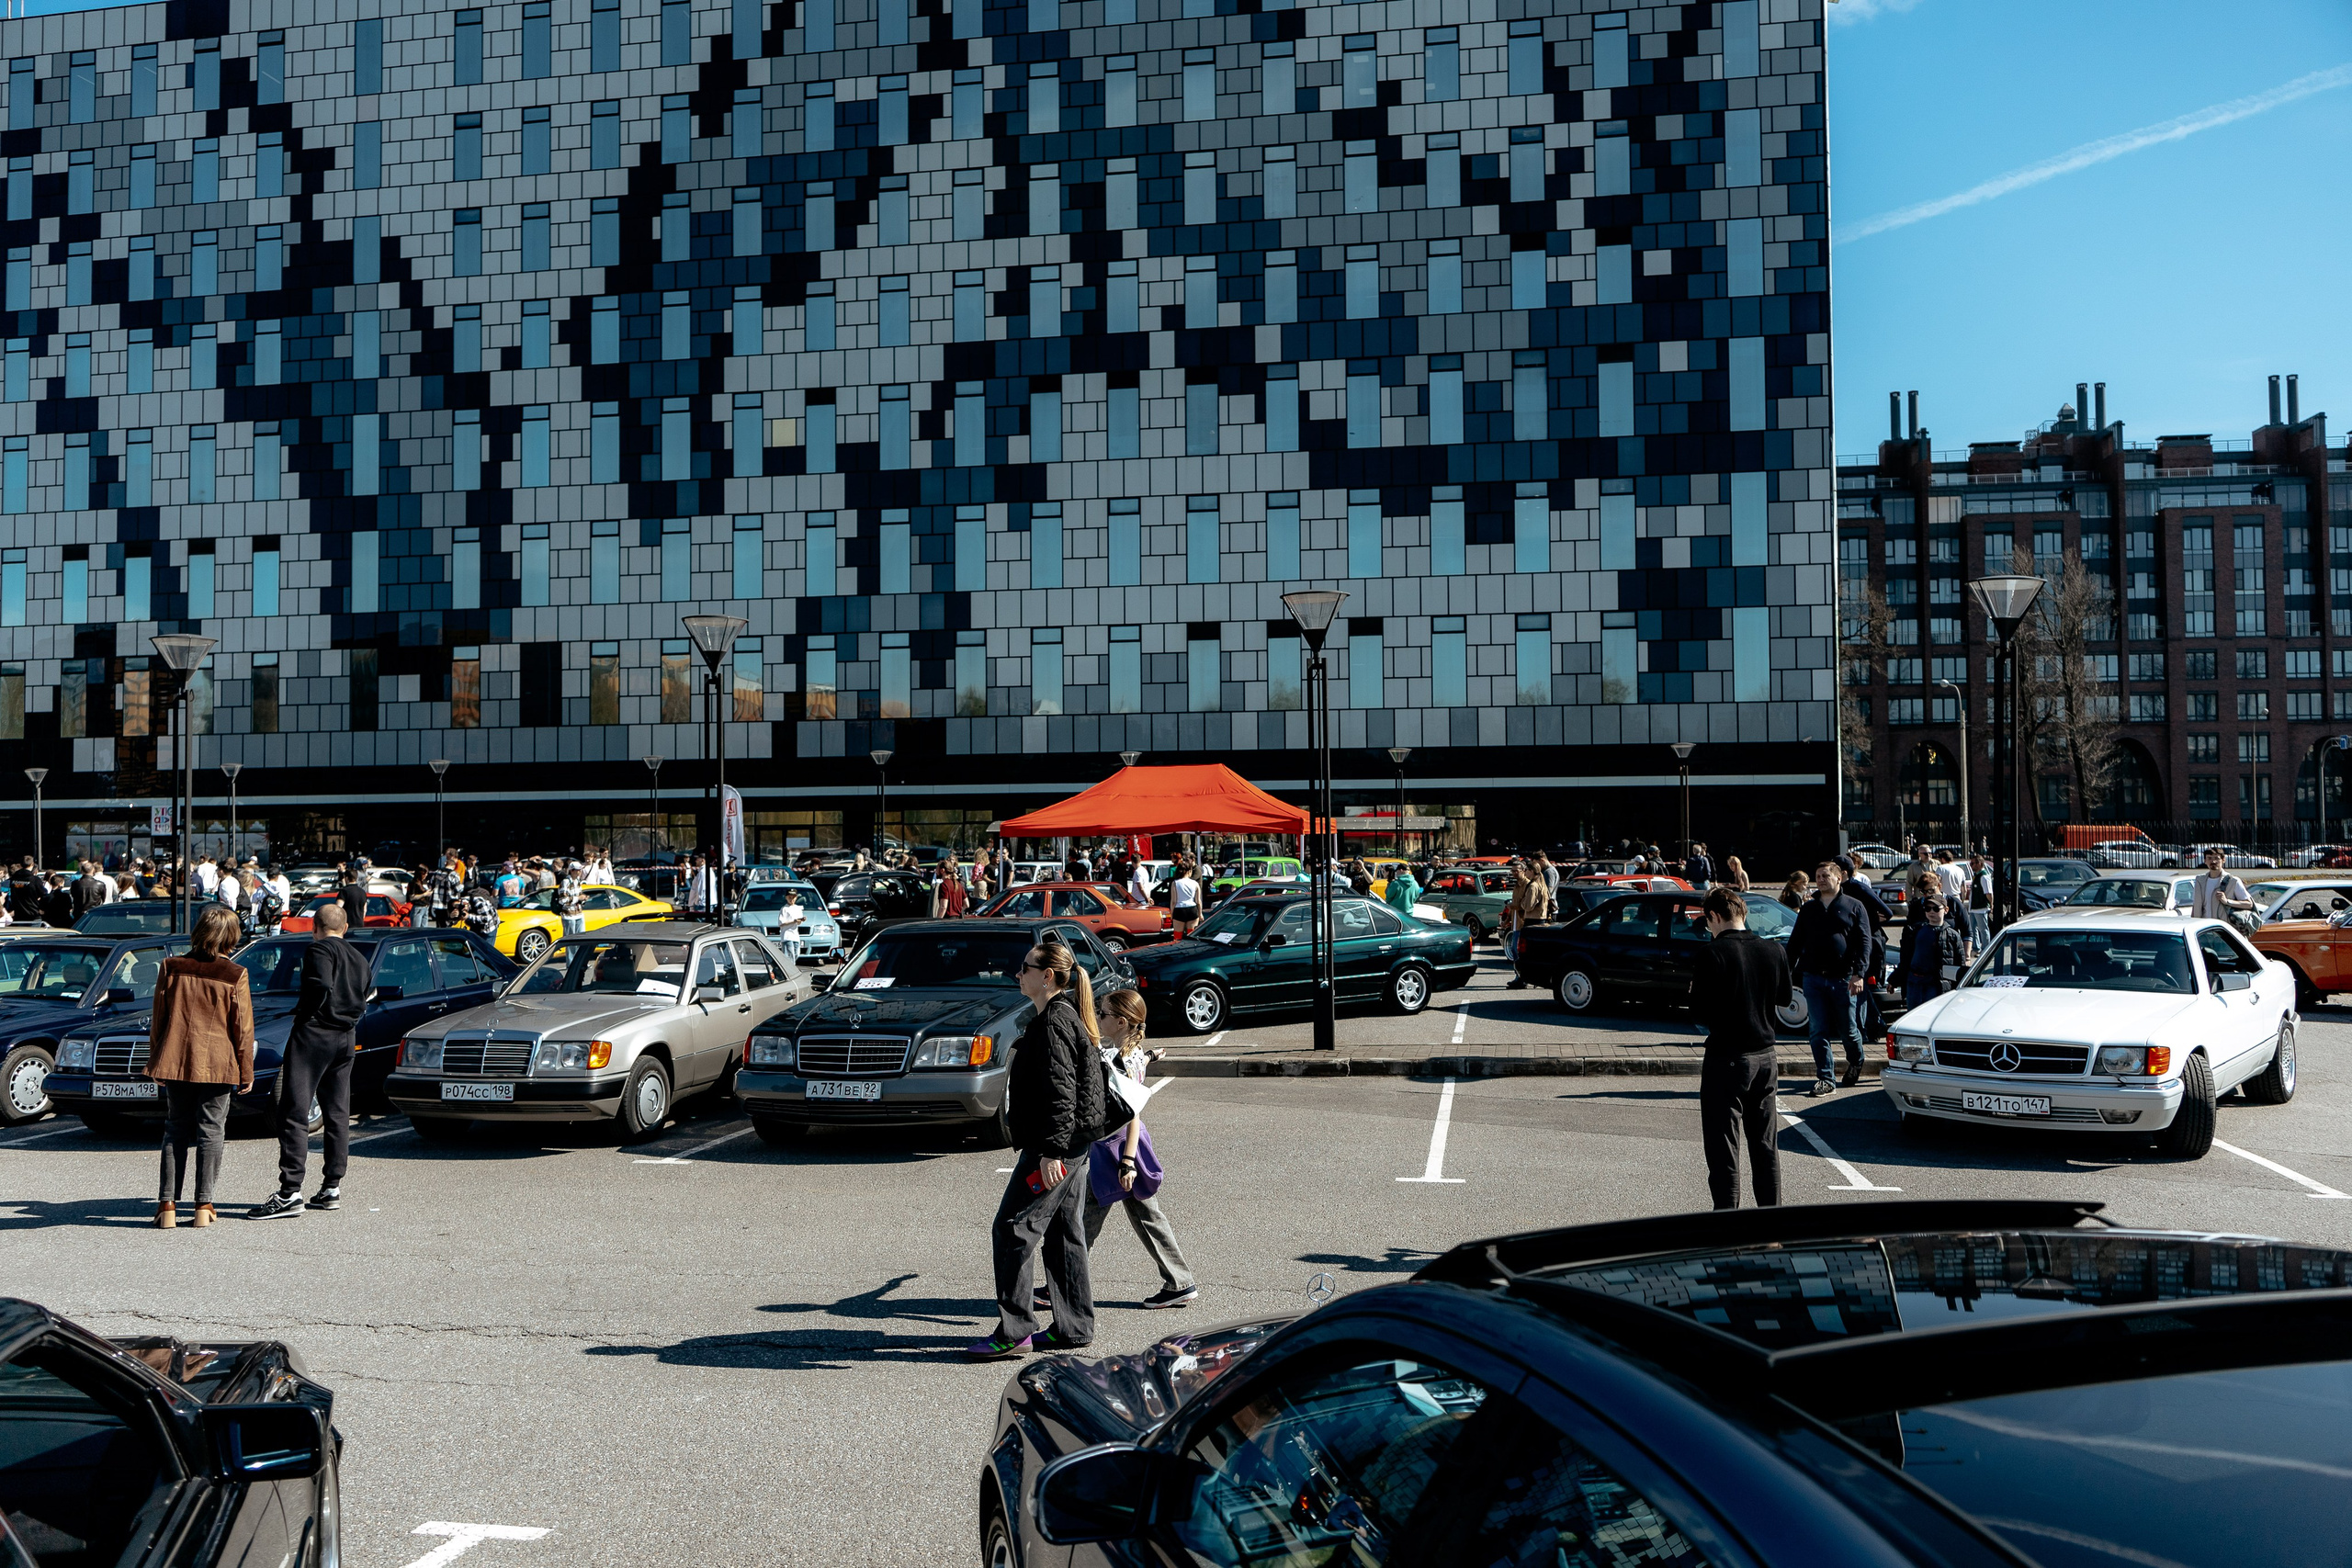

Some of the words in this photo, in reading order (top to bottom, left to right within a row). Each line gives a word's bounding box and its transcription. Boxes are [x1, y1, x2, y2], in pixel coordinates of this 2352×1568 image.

[96, 1084, 135, 1096] Р578МА
[138, 1084, 155, 1093] 198
[446, 1085, 489, 1098] Р074СС
[492, 1085, 510, 1095] 198
[811, 1082, 859, 1096] А731ВЕ
[865, 1083, 876, 1093] 92
[1967, 1096, 2021, 1111] В121ТО
[2023, 1099, 2045, 1110] 147
